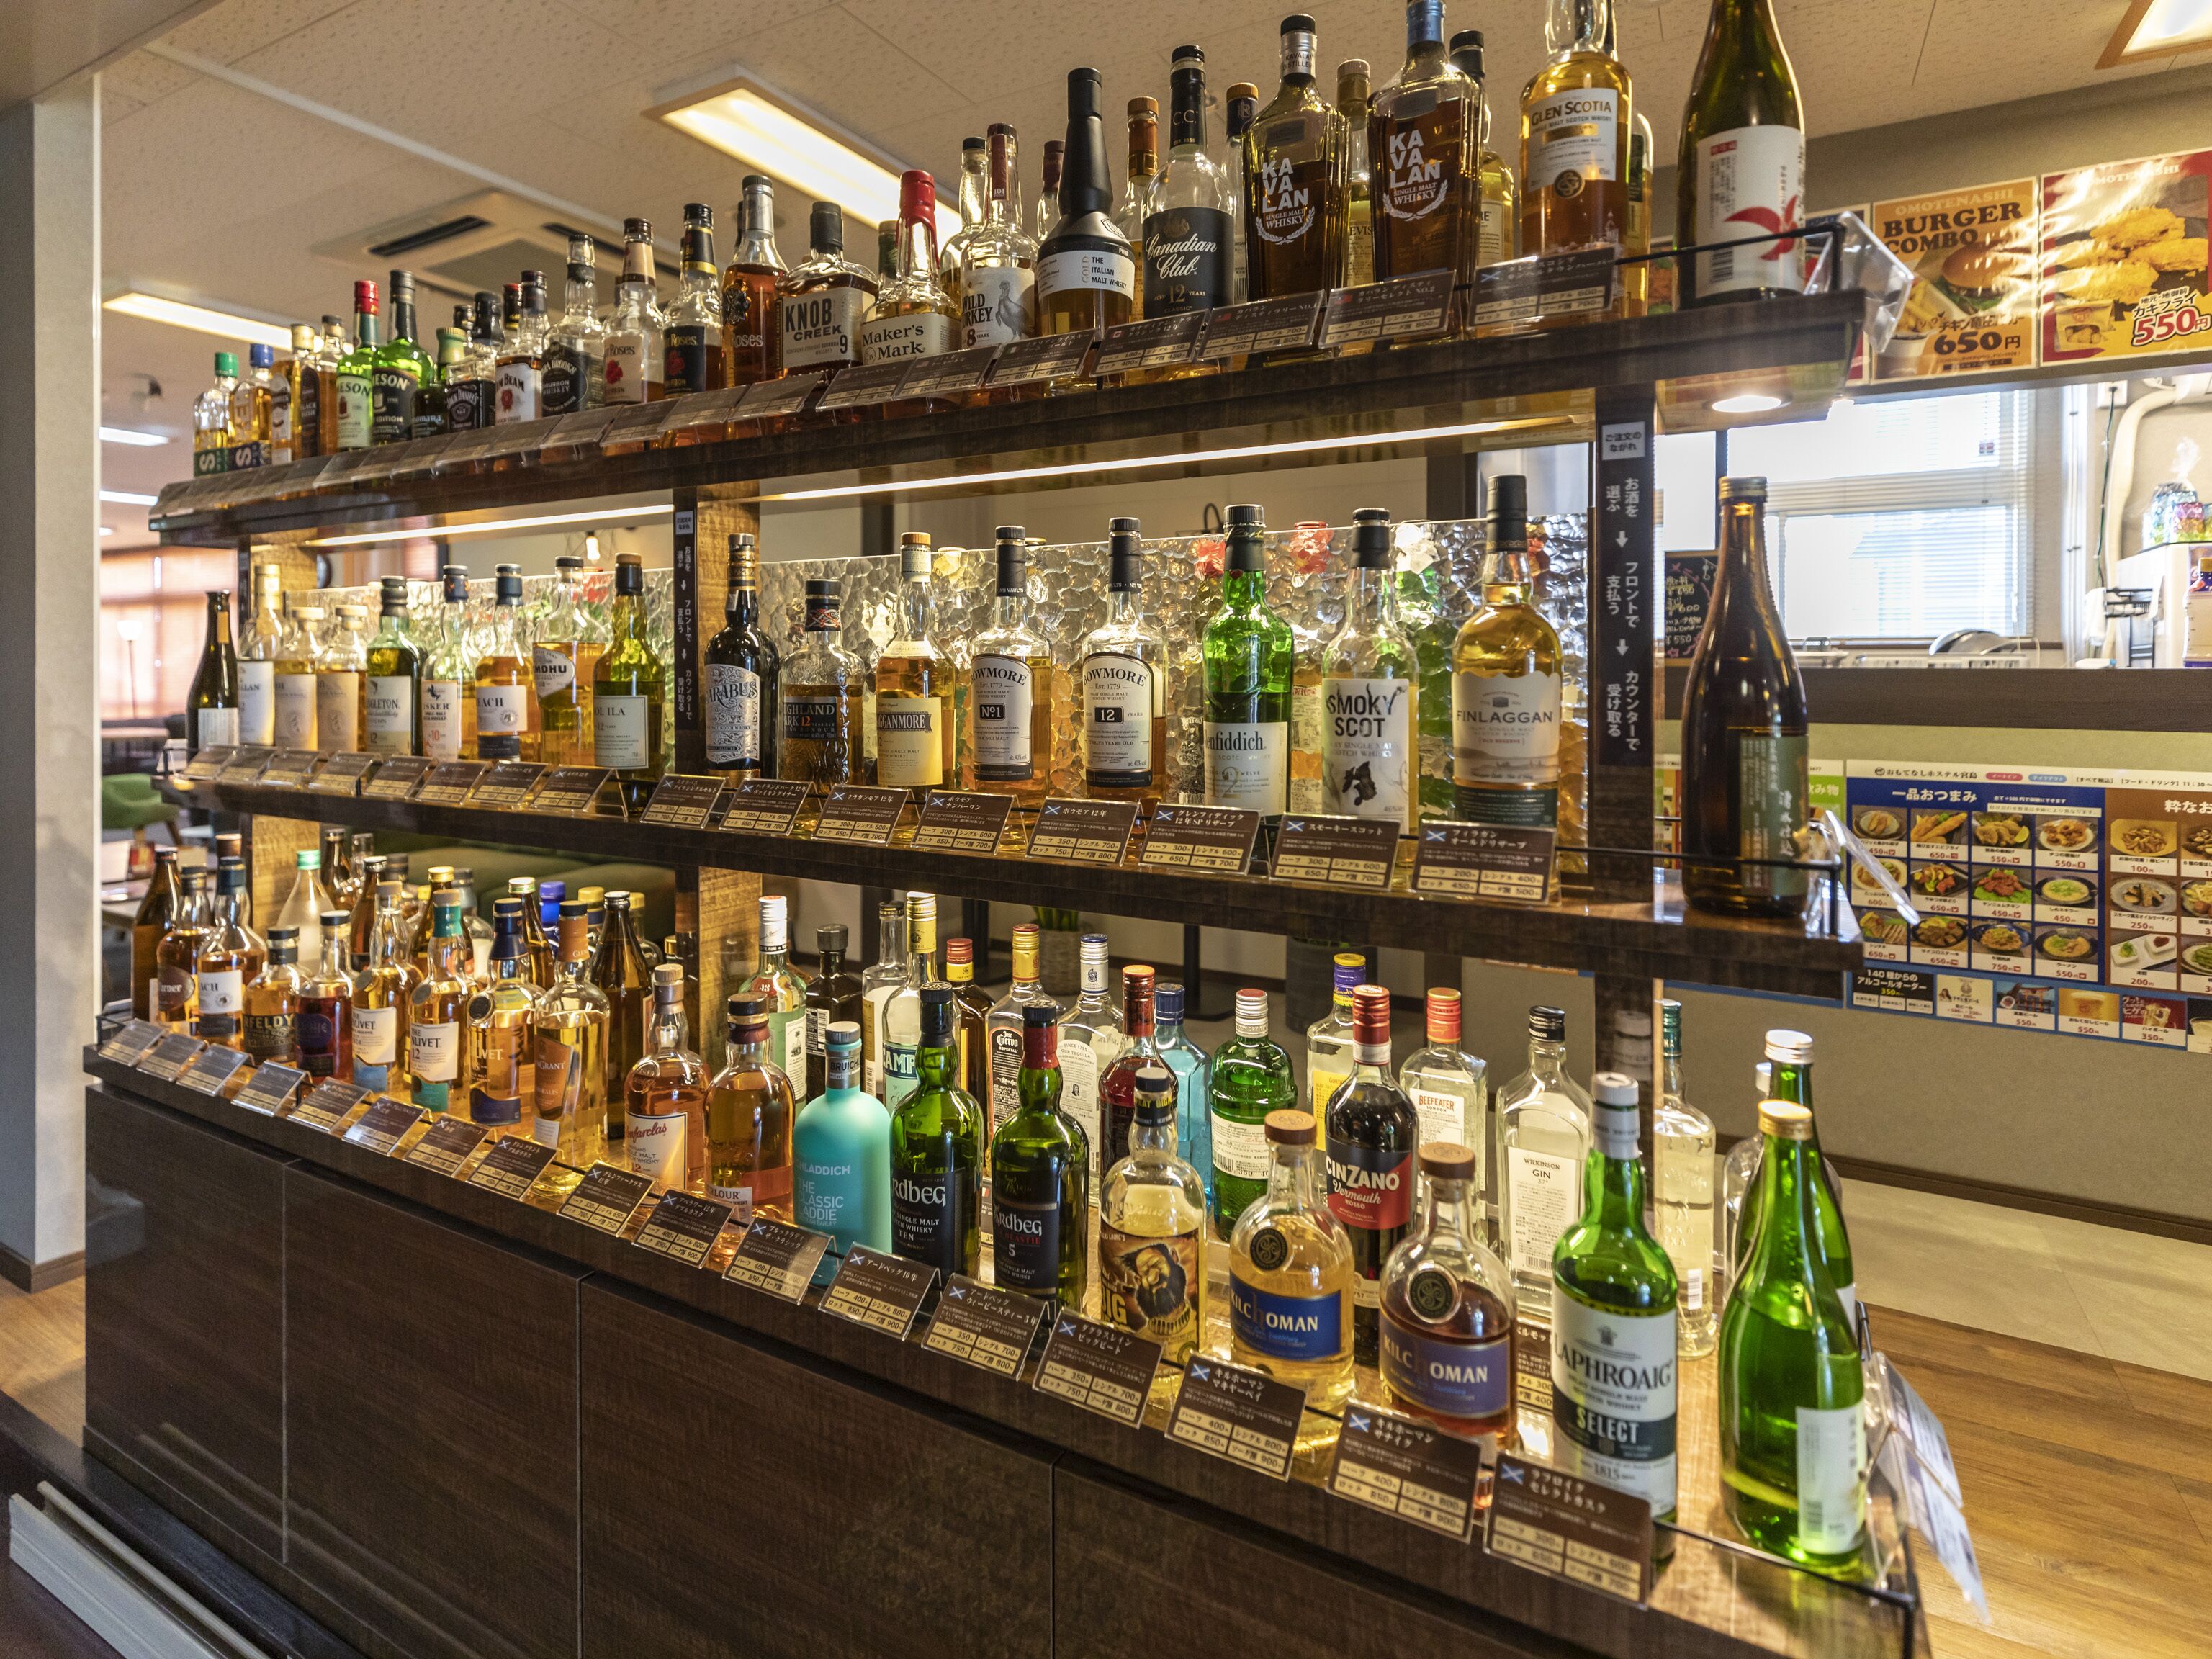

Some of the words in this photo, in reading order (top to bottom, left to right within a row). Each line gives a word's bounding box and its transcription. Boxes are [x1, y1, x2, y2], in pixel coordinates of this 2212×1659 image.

[1532, 106, 1562, 125] GLEN
[1565, 101, 1611, 114] SCOTIA
[1390, 130, 1424, 153] KA
[1263, 158, 1294, 179] KA
[1390, 148, 1424, 171] VA
[1263, 175, 1293, 195] VA
[1390, 162, 1441, 189] LAN
[1394, 185, 1416, 195] SINGLE
[1418, 181, 1437, 191] MALT
[1394, 189, 1437, 205] WHISKY
[1262, 188, 1308, 214] LAN
[1896, 189, 2013, 215] OMOTENASHI
[1266, 212, 1287, 221] SINGLE
[1267, 216, 1304, 229] WHISKY
[1884, 202, 2023, 238] BURGER
[1146, 233, 1217, 261] Canadian
[1887, 229, 1978, 254] COMBO
[1092, 266, 1114, 276] ITALIAN
[1156, 255, 1197, 279] Club
[1110, 279, 1126, 289] WHISKY
[1169, 284, 1185, 303] 12
[786, 298, 832, 332] KNOB
[2134, 293, 2197, 318] カキフライ
[794, 325, 841, 341] CREEK
[863, 325, 924, 346] Maker's
[2133, 307, 2210, 345] 550円
[840, 335, 848, 354] 9
[966, 329, 976, 346] 8
[1934, 331, 2020, 355] 650円
[878, 342, 923, 360] Mark
[505, 374, 525, 392] BEAM
[1606, 432, 1642, 441] ご注文の
[1610, 443, 1637, 451] ながれ
[1606, 485, 1620, 511] 選ぶ
[1625, 477, 1639, 517] お酒を
[1606, 575, 1621, 615] 支払う
[1625, 562, 1640, 628] フロントで
[1084, 668, 1146, 686] BOWMORE
[1326, 694, 1393, 715] SMOKY
[1606, 684, 1621, 737] 受け取る
[1626, 670, 1640, 750] カウンターで
[801, 716, 810, 726] 12
[1101, 710, 1115, 721] 12
[1457, 710, 1553, 724] FINLAGGAN
[1334, 717, 1385, 737] SCOT
[1211, 766, 1240, 798] 12
[1887, 769, 1977, 779] おもてなしホステル宮島
[1892, 788, 1977, 803] 一品おつまみ
[1178, 809, 1244, 820] グレンフィディック
[1309, 824, 1383, 835] スモーキースコット
[1451, 837, 1527, 849] オールドリザーブ
[1857, 976, 1927, 991] アルコールオーダー
[1887, 971, 1918, 981] 種からの
[997, 1034, 1018, 1047] Cuervo
[1419, 1094, 1455, 1110] BEEFEATER
[631, 1163, 641, 1172] 12
[1326, 1155, 1400, 1191] CINZANO
[1524, 1158, 1560, 1169] WILKINSON
[1532, 1169, 1551, 1179] GIN
[1332, 1179, 1382, 1205] Vermouth
[1345, 1199, 1365, 1210] ROSSO
[899, 1230, 914, 1241] TEN
[906, 1225, 932, 1233] WHISKY
[1009, 1243, 1015, 1256] 5
[867, 1259, 904, 1277] アードベッグ
[903, 1270, 918, 1282] 10年
[1012, 1271, 1030, 1280] WHISKY
[971, 1289, 1010, 1305] アードベッグ
[966, 1298, 1022, 1319] ウィービースティー
[1082, 1324, 1132, 1346] ダグラスレイン
[1215, 1367, 1266, 1390] キルホーマン
[1376, 1418, 1434, 1444] キルホーマン
[1577, 1405, 1640, 1444] SELECT
